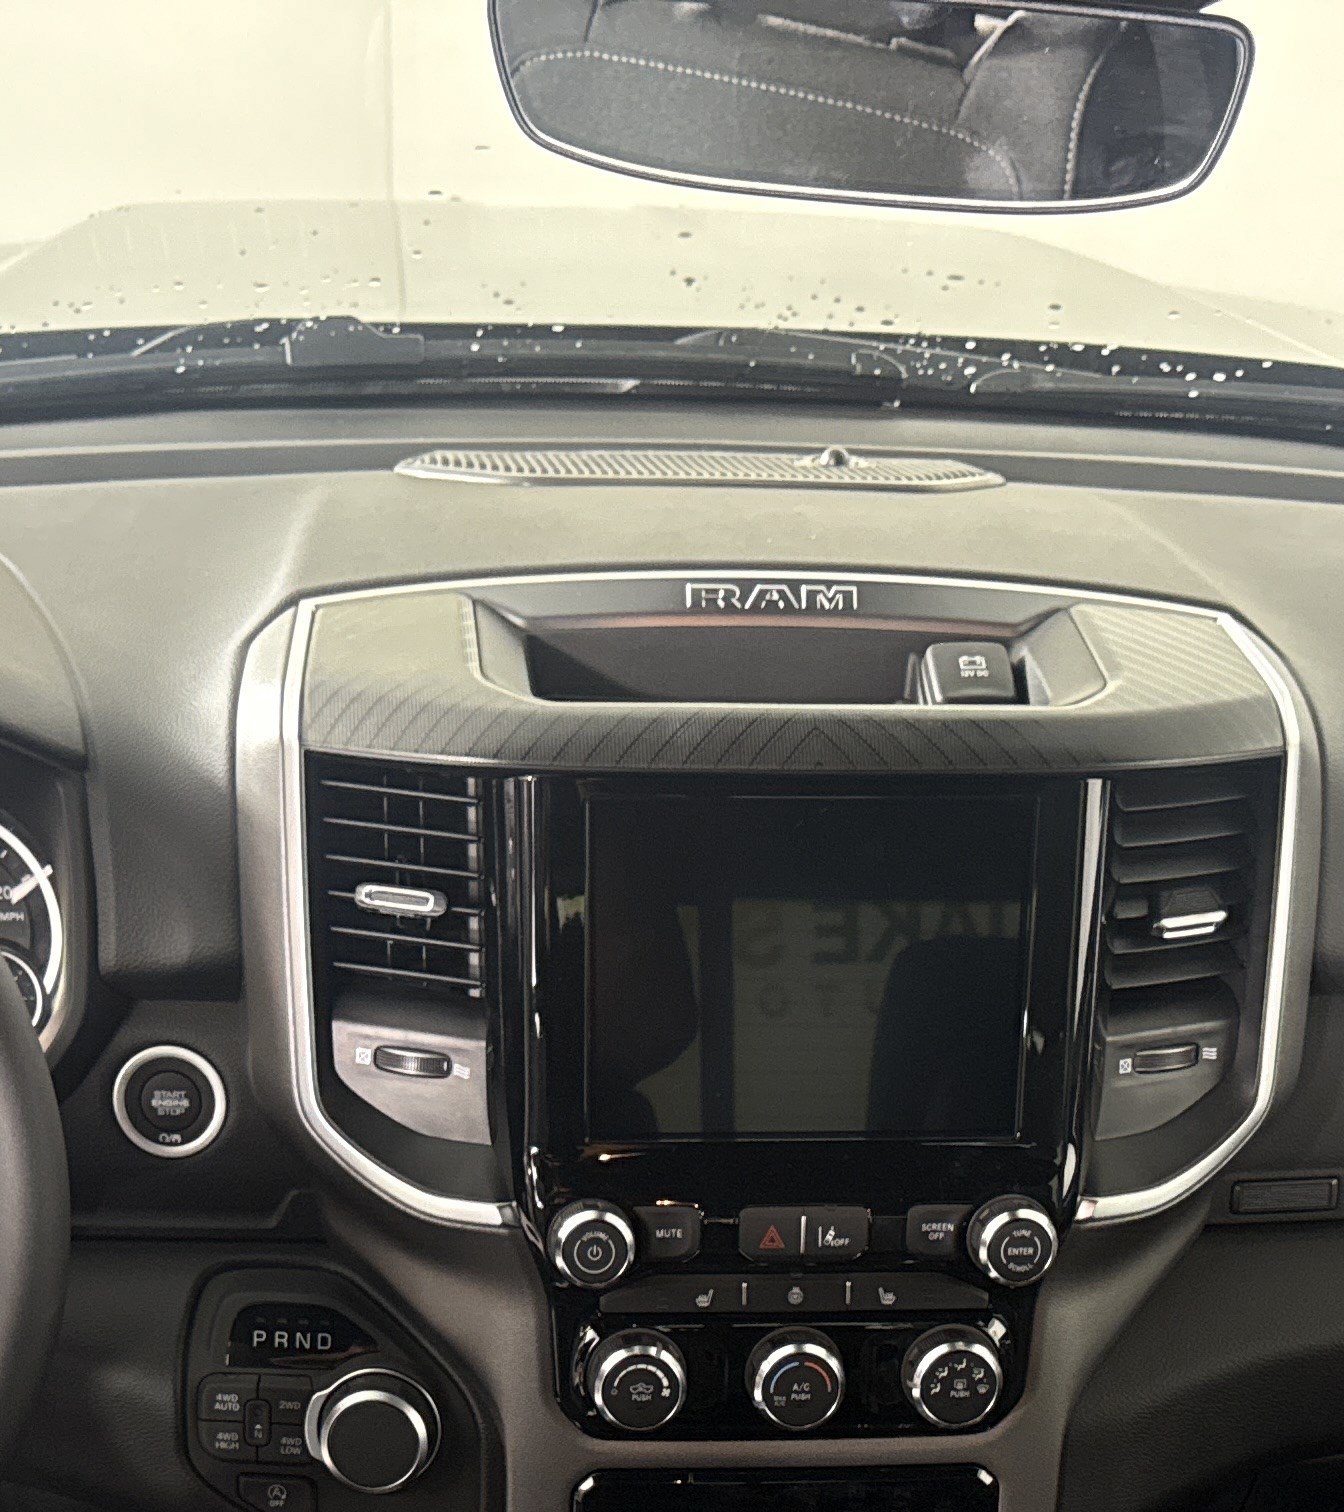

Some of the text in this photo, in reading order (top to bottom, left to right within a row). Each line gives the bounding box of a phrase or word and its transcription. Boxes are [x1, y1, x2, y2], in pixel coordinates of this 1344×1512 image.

[684, 582, 858, 610] RAM
[153, 1090, 187, 1099] START
[157, 1106, 186, 1116] STOP
[921, 1223, 955, 1232] SCREEN
[656, 1228, 683, 1239] MUTE
[928, 1232, 945, 1241] OFF
[1007, 1247, 1034, 1256] ENTER
[252, 1329, 332, 1351] P R N D
[792, 1382, 811, 1392] A/C
[216, 1393, 239, 1402] 4WD
[631, 1393, 652, 1402] PUSH
[790, 1392, 811, 1401] PUSH
[214, 1401, 241, 1412] AUTO
[279, 1400, 301, 1410] 2WD
